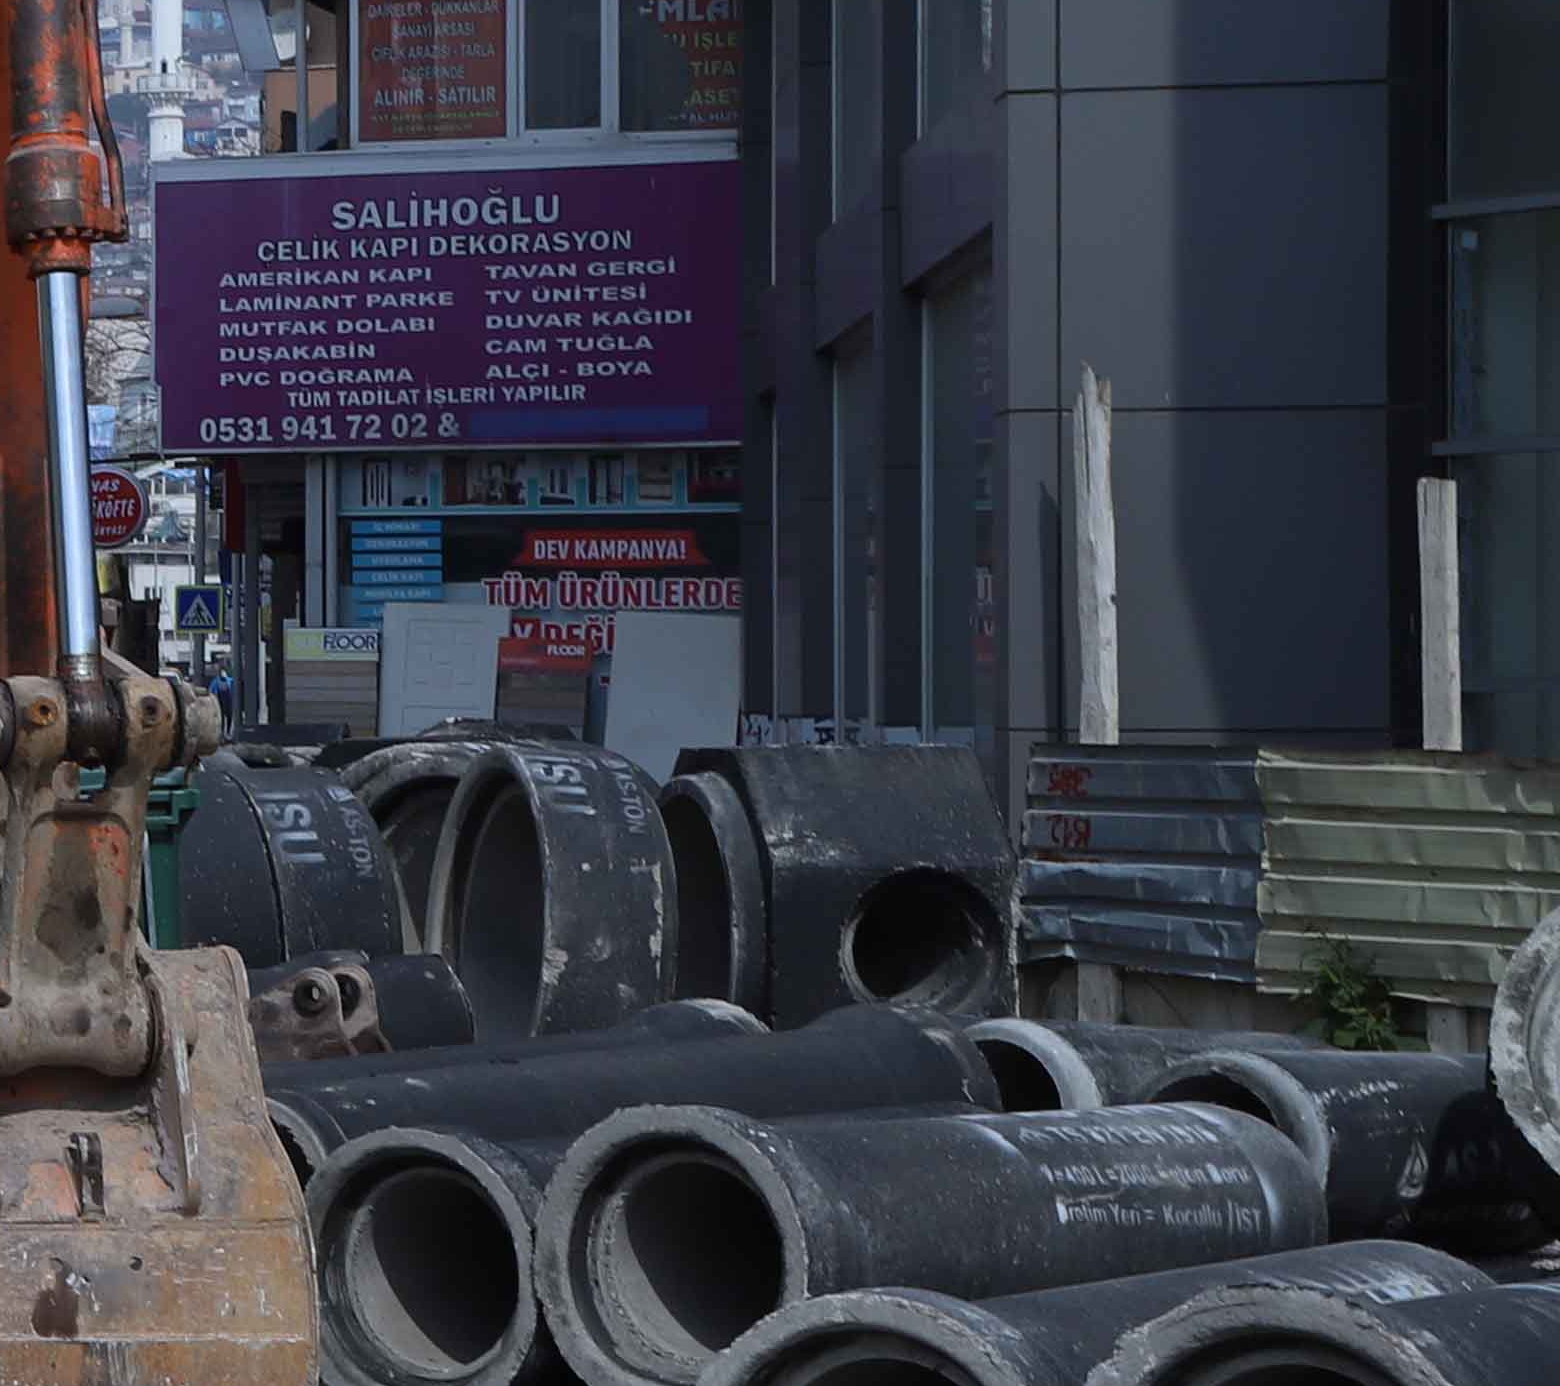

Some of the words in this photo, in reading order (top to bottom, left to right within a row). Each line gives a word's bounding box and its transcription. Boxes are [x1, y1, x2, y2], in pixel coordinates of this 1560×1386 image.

[375, 88, 424, 109] ALINIR
[438, 85, 496, 106] SATILIR
[332, 187, 560, 230] SALİHOĞLU
[258, 233, 339, 267] ÇELİK
[351, 236, 417, 259] KAPI
[429, 229, 632, 256] DEKORASYON
[220, 267, 359, 288] AMERİKAN
[369, 266, 432, 284] KAPI
[485, 263, 577, 280] TAVAN
[587, 256, 676, 277] GERGİ
[220, 291, 357, 313] LAMİNANT
[366, 290, 455, 309] PARKE
[485, 289, 522, 305] TV
[532, 281, 647, 304] ÜNİTESİ
[220, 319, 328, 338] MUTFAK
[337, 317, 435, 335] DOLABI
[486, 313, 582, 330] DUVAR
[592, 307, 693, 327] KAĞIDI
[221, 341, 376, 364] DUŞAKABİN
[486, 338, 546, 355] CAM
[556, 333, 654, 353] TUĞLA
[221, 370, 271, 387] PVC
[280, 364, 414, 386] DOĞRAMA
[486, 362, 549, 382] ALÇI
[577, 360, 653, 378] BOYA
[288, 388, 330, 409] TÜM
[337, 385, 421, 406] TADİLAT
[426, 381, 495, 408] İŞLERİ
[502, 383, 586, 403] YAPILIR
[200, 417, 272, 443] 0531
[281, 415, 336, 441] 941
[346, 414, 381, 439] 72
[391, 412, 428, 438] 02
[437, 412, 460, 438] &
[534, 539, 569, 560] DEV
[575, 538, 687, 560] KAMPANYA!
[481, 570, 551, 611] TÜM
[556, 569, 744, 612] ÜRÜNLERDE
